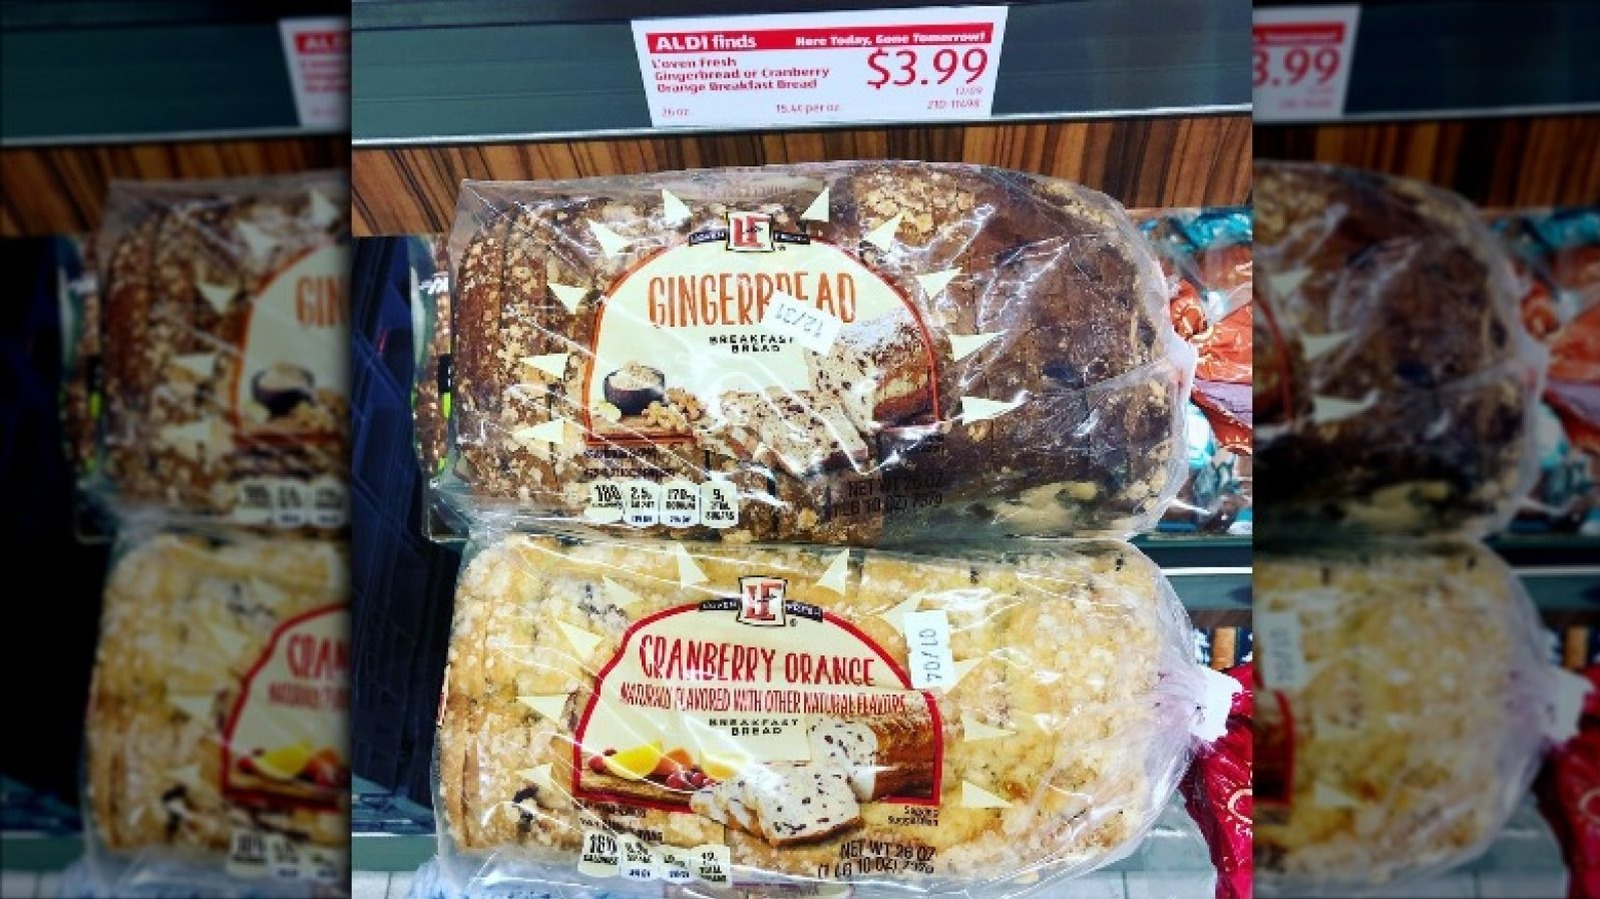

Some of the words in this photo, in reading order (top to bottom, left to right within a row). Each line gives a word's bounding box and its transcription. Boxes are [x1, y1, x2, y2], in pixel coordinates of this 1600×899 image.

[655, 36, 709, 50] ALDI
[711, 34, 757, 49] finds
[796, 36, 827, 46] Here
[830, 35, 873, 47] Today,
[876, 34, 909, 44] Gone
[913, 31, 986, 43] Tomorrow!
[700, 57, 737, 68] Fresh
[866, 47, 988, 89] $3.99
[655, 69, 740, 83] Gingerbread
[744, 70, 757, 78] or
[762, 67, 830, 79] Cranberry
[657, 83, 706, 94] Orange
[709, 80, 774, 91] Breakfast
[777, 79, 818, 89] Bread
[639, 634, 776, 683] CRANBERRY
[785, 653, 876, 687] ORANGE
[919, 628, 942, 682] 01/04
[675, 686, 731, 712] FLAVORED
[733, 688, 762, 712] WITH
[764, 690, 801, 714] OTHER
[803, 692, 855, 715] NATURAL
[857, 693, 907, 715] FLAVORS
[731, 727, 782, 736] BREAD
[841, 840, 865, 860] NET
[869, 840, 890, 856] WT
